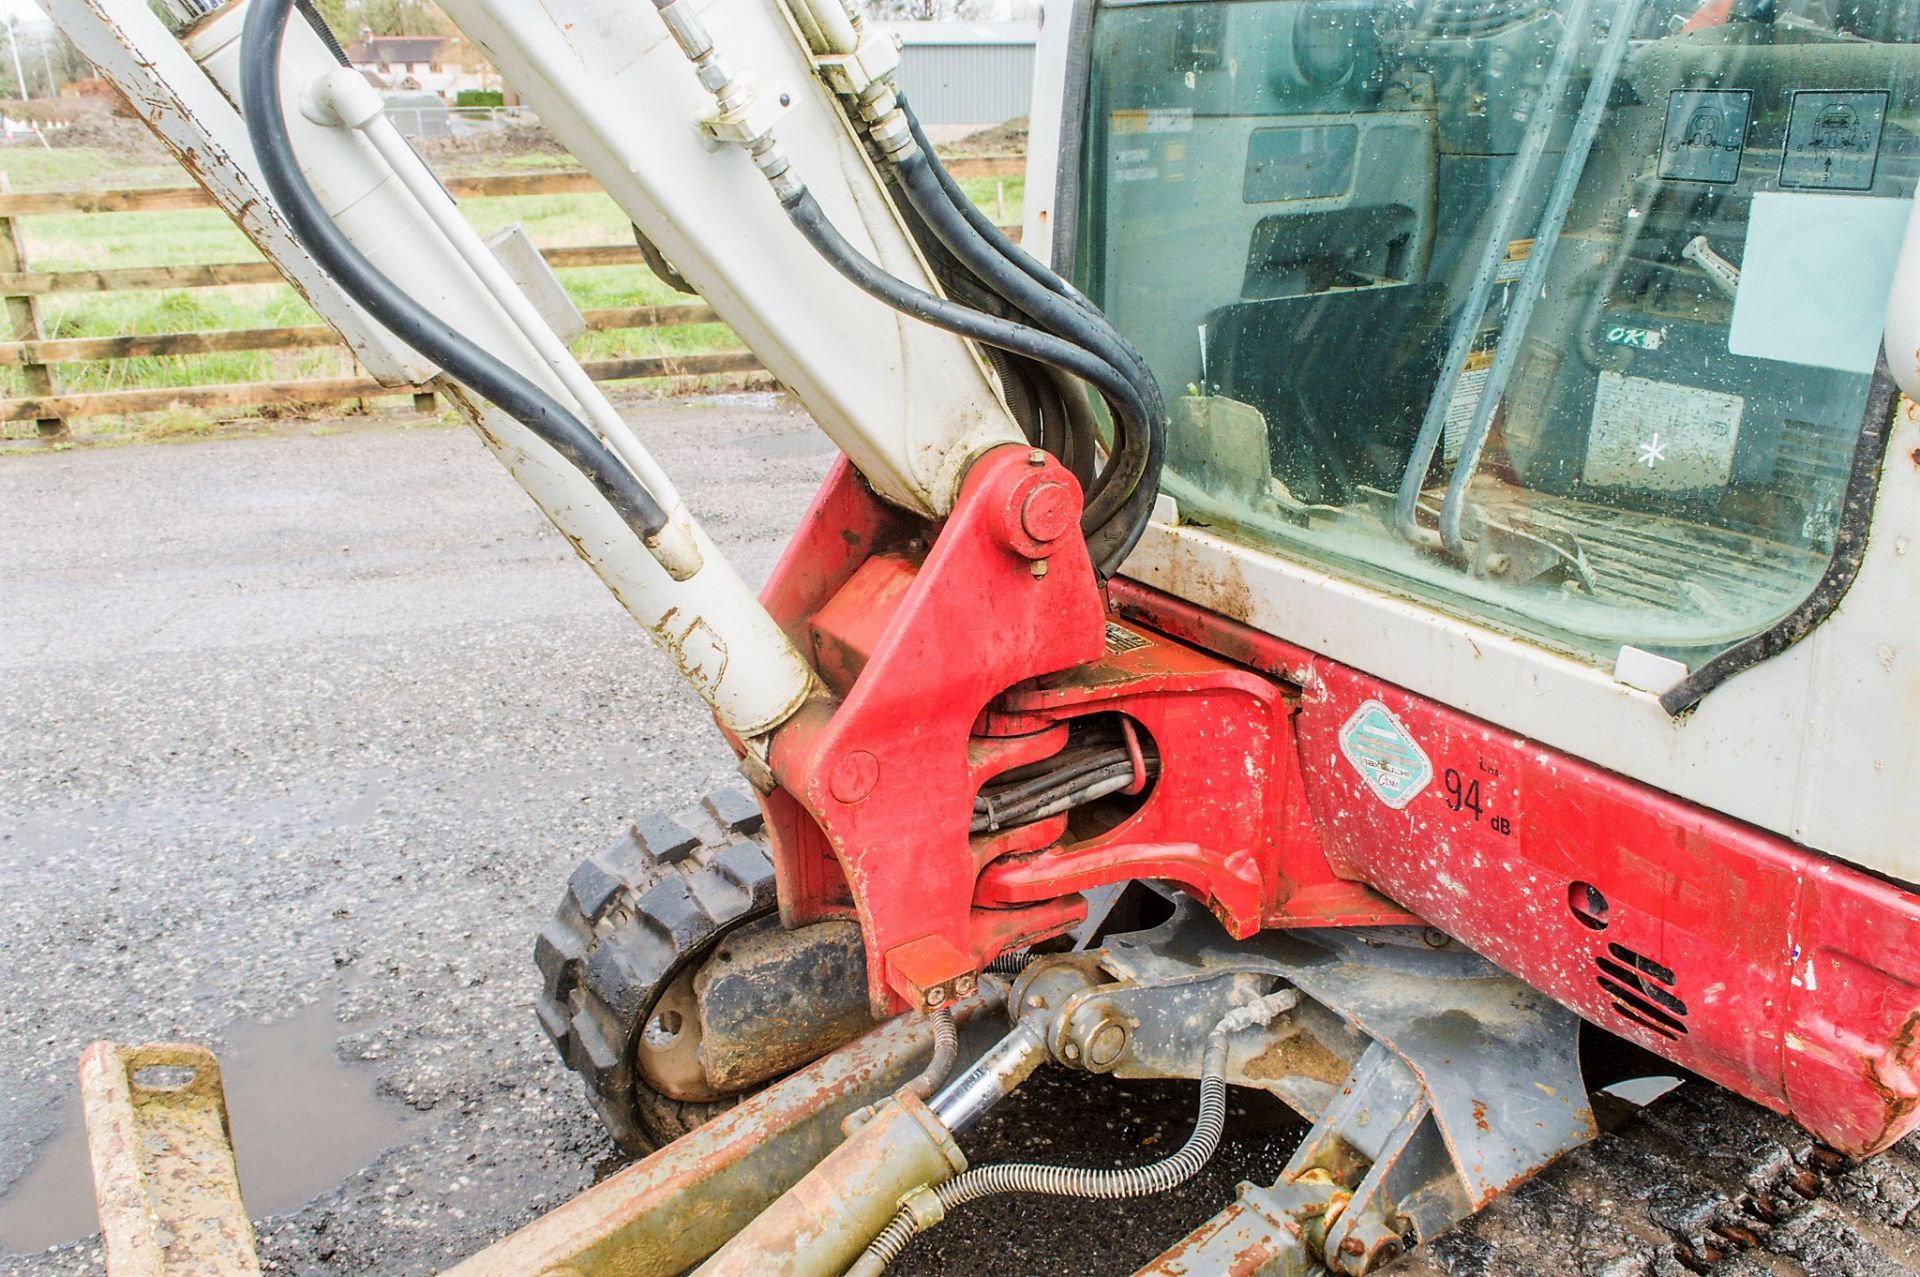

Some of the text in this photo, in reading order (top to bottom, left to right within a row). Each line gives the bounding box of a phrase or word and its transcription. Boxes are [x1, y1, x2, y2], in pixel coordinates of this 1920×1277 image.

[1606, 327, 1646, 345] OK
[1445, 768, 1484, 822] 94
[1491, 815, 1511, 837] dB
